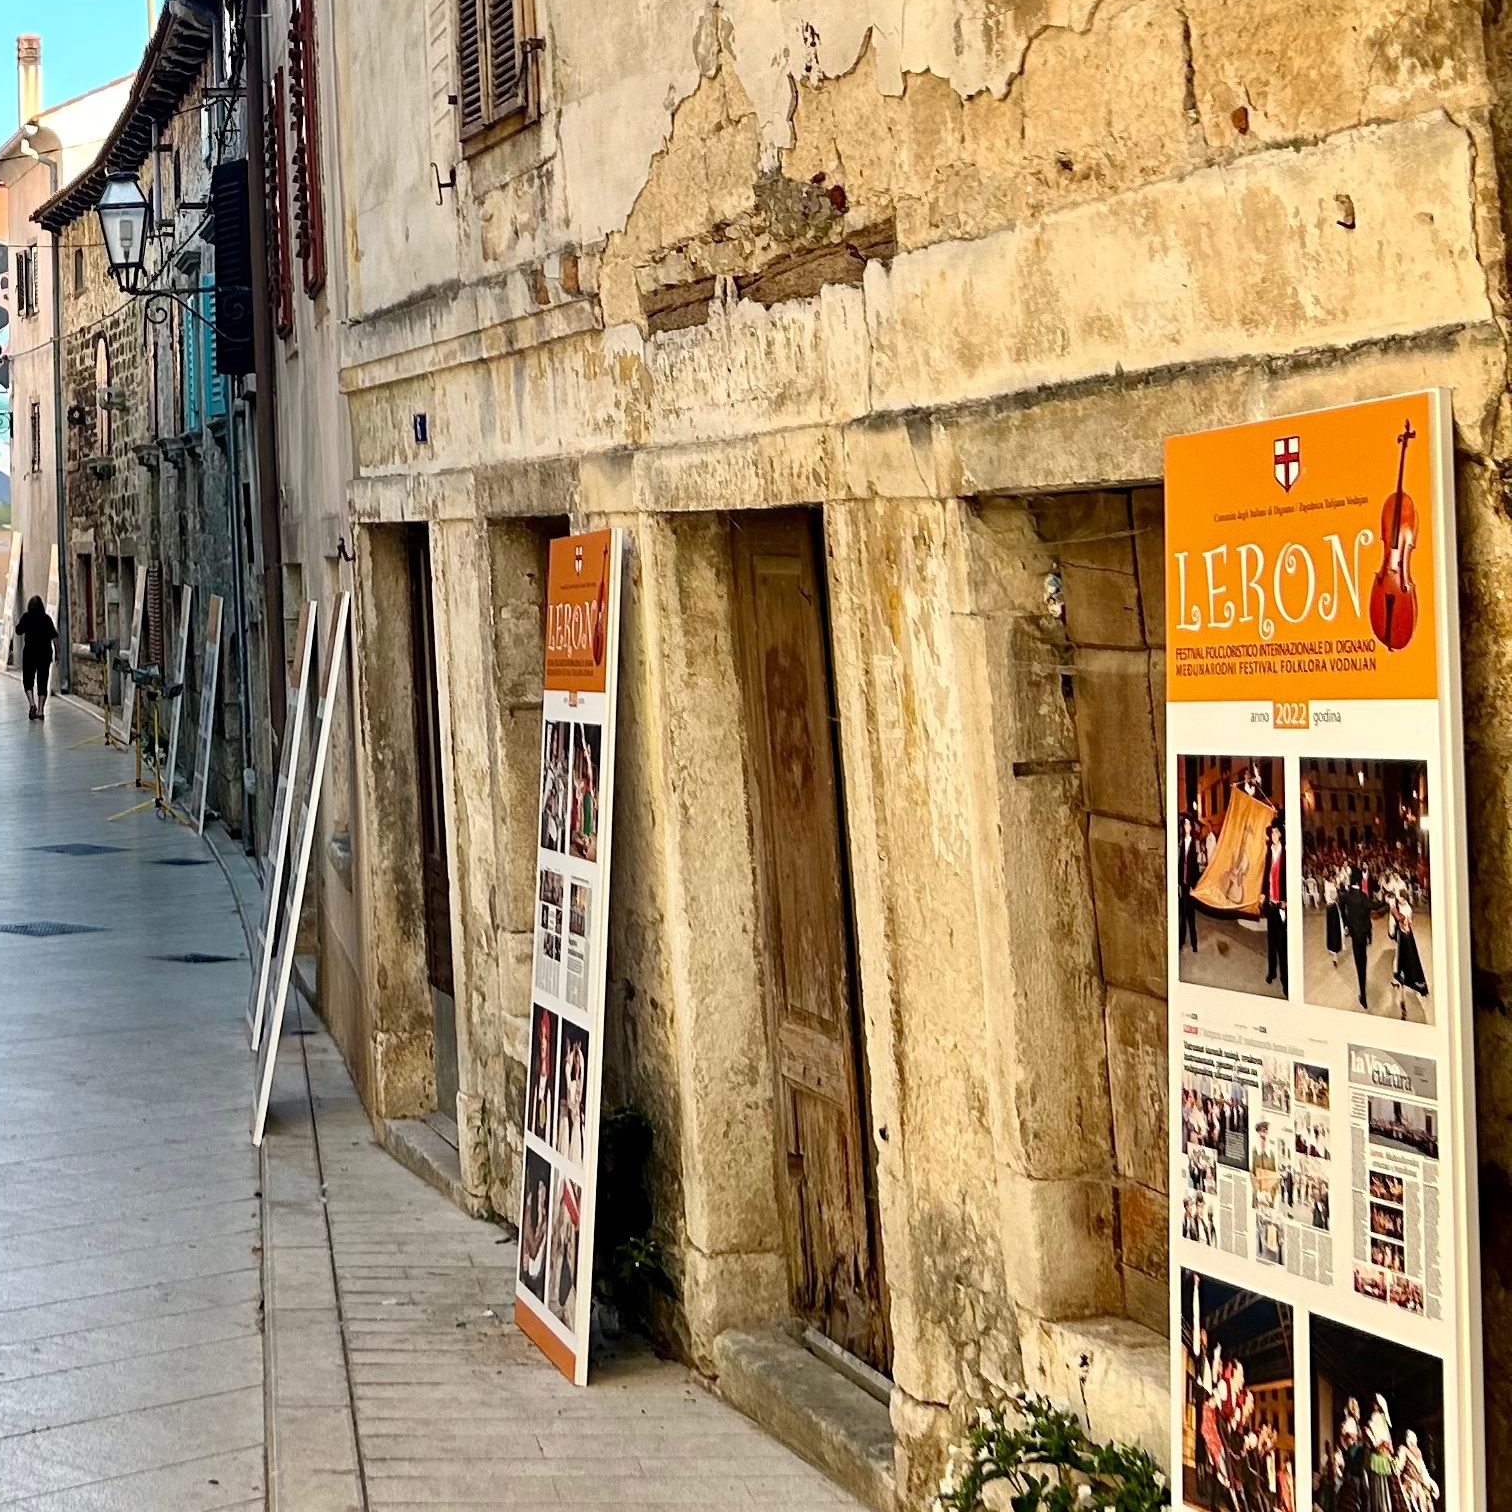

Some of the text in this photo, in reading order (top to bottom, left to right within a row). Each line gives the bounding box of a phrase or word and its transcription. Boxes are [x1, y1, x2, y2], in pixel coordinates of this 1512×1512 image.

[1174, 529, 1374, 641] LERON
[548, 599, 597, 659] LERON
[1175, 646, 1204, 661] FESTIVAL
[1258, 640, 1323, 657] INTERNAZIONALE
[1324, 640, 1333, 654] DI
[1336, 638, 1376, 654] DIGNANO
[1239, 660, 1278, 675] FESTIVAL
[1280, 658, 1327, 674] FOLKLORA
[1330, 656, 1376, 672] VODNJAN
[1250, 702, 1342, 727] anno 2022 godina
